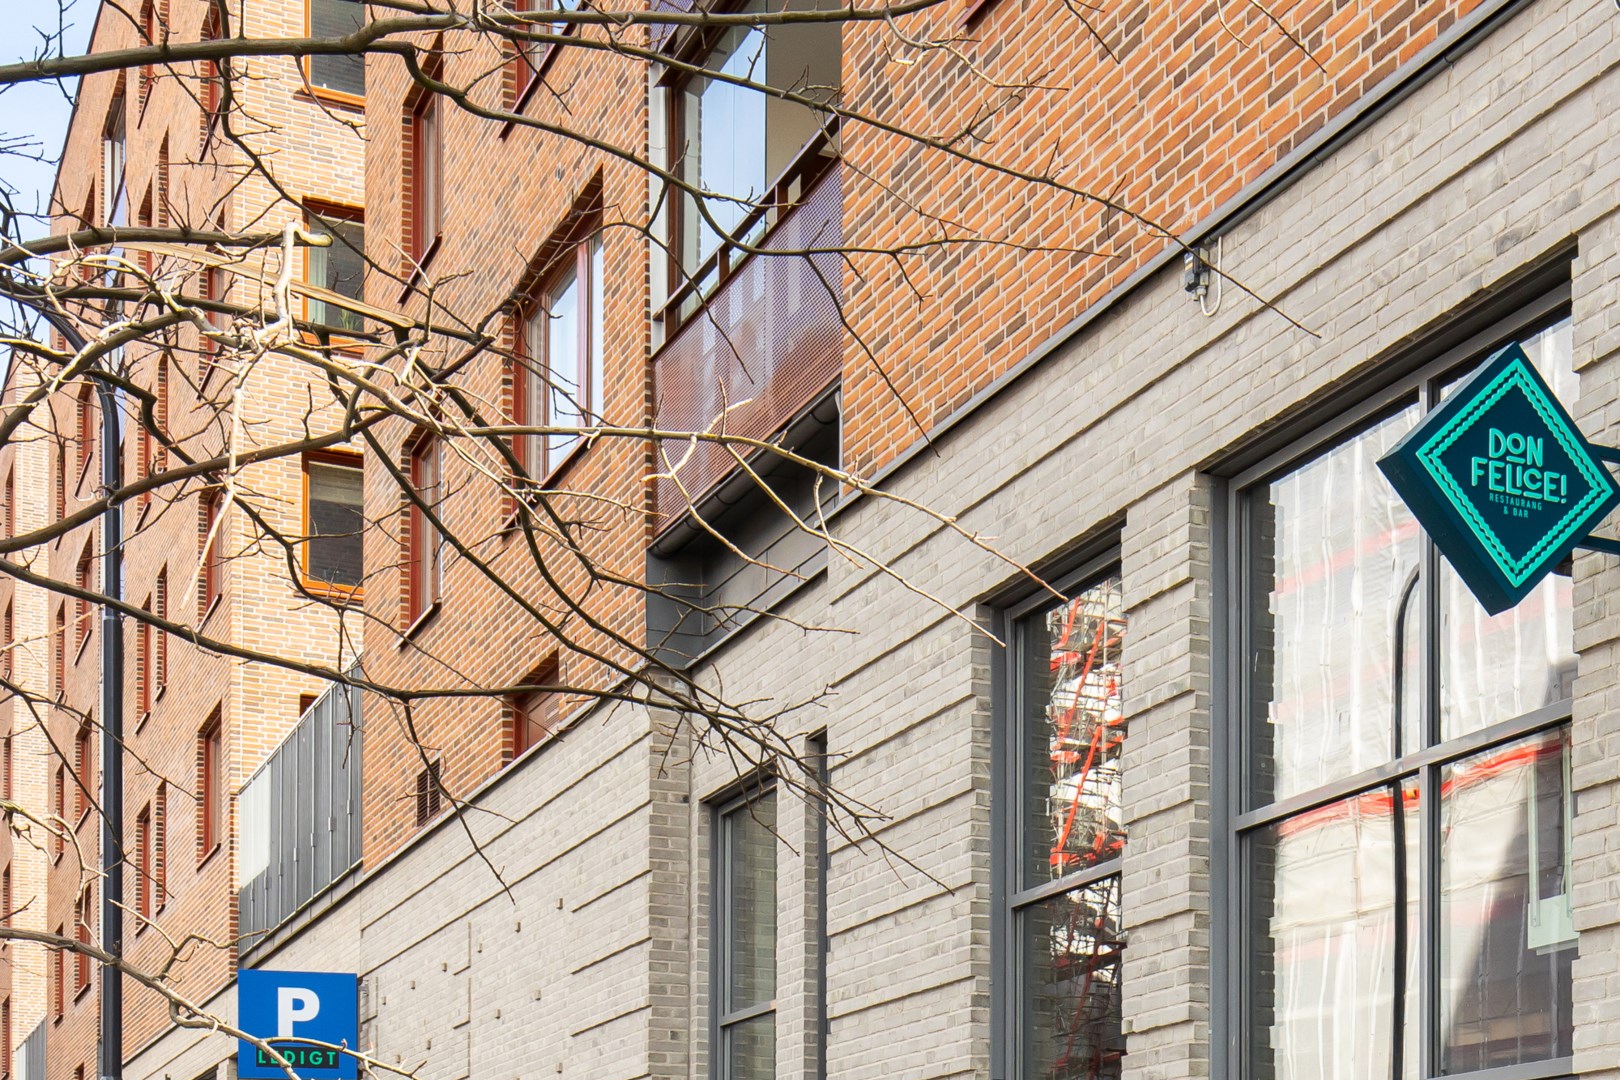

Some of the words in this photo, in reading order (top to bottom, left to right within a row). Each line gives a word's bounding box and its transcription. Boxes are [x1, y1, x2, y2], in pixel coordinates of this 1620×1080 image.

[1488, 427, 1543, 467] DON
[1471, 456, 1567, 503] FELICE!
[1489, 492, 1542, 510] RESTAURANG
[1503, 505, 1508, 515] &
[1512, 507, 1529, 518] BAR
[277, 987, 320, 1038] P
